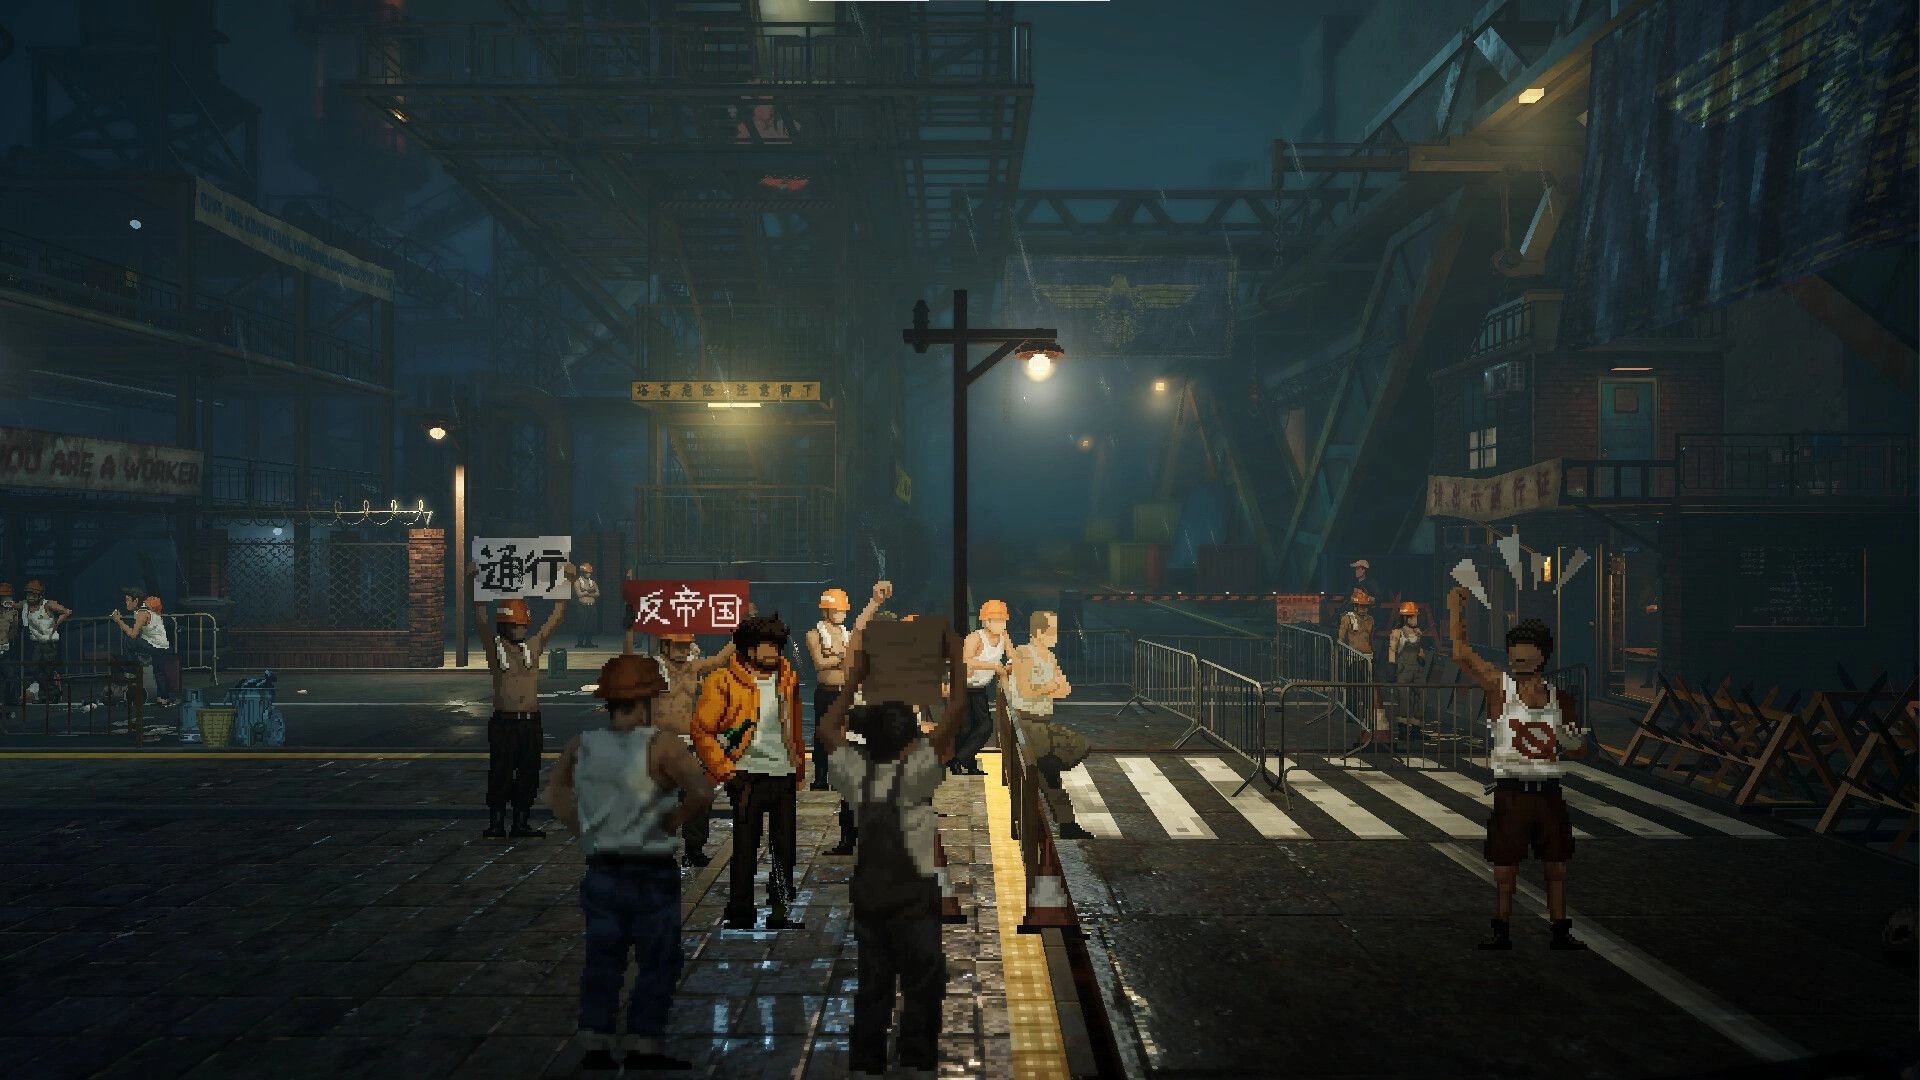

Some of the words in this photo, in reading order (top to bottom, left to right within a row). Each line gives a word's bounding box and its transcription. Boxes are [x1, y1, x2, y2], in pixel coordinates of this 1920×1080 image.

[50, 450, 95, 477] ARE
[100, 454, 116, 479] A
[124, 456, 200, 485] WORKER
[480, 544, 567, 593] 通行
[634, 584, 742, 629] 反帝国
